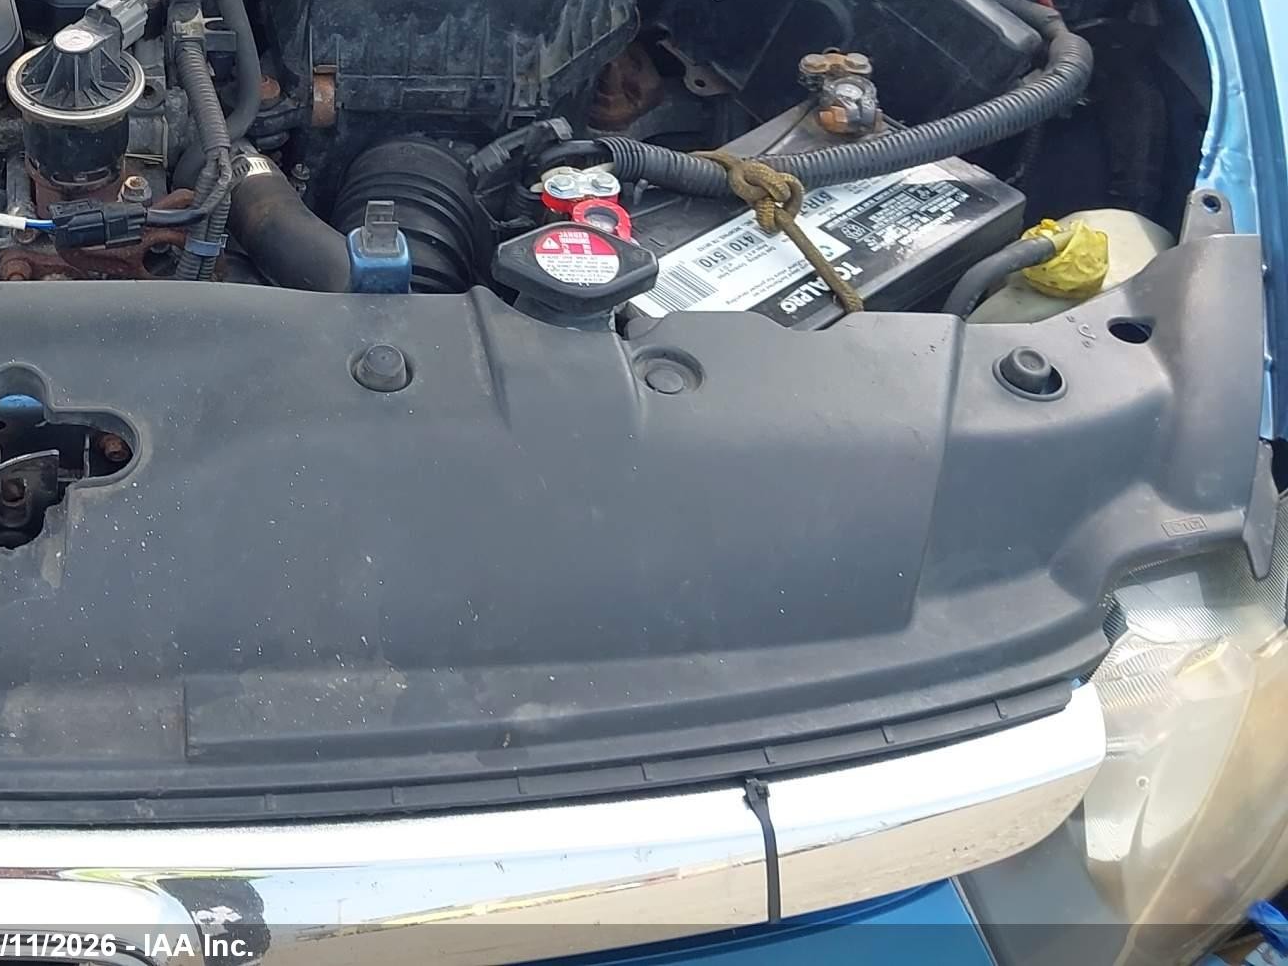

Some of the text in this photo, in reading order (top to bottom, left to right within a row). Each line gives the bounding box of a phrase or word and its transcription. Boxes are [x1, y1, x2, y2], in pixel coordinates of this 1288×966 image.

[729, 233, 756, 252] 410
[699, 249, 726, 269] 510
[778, 260, 863, 315] TOALPRO
